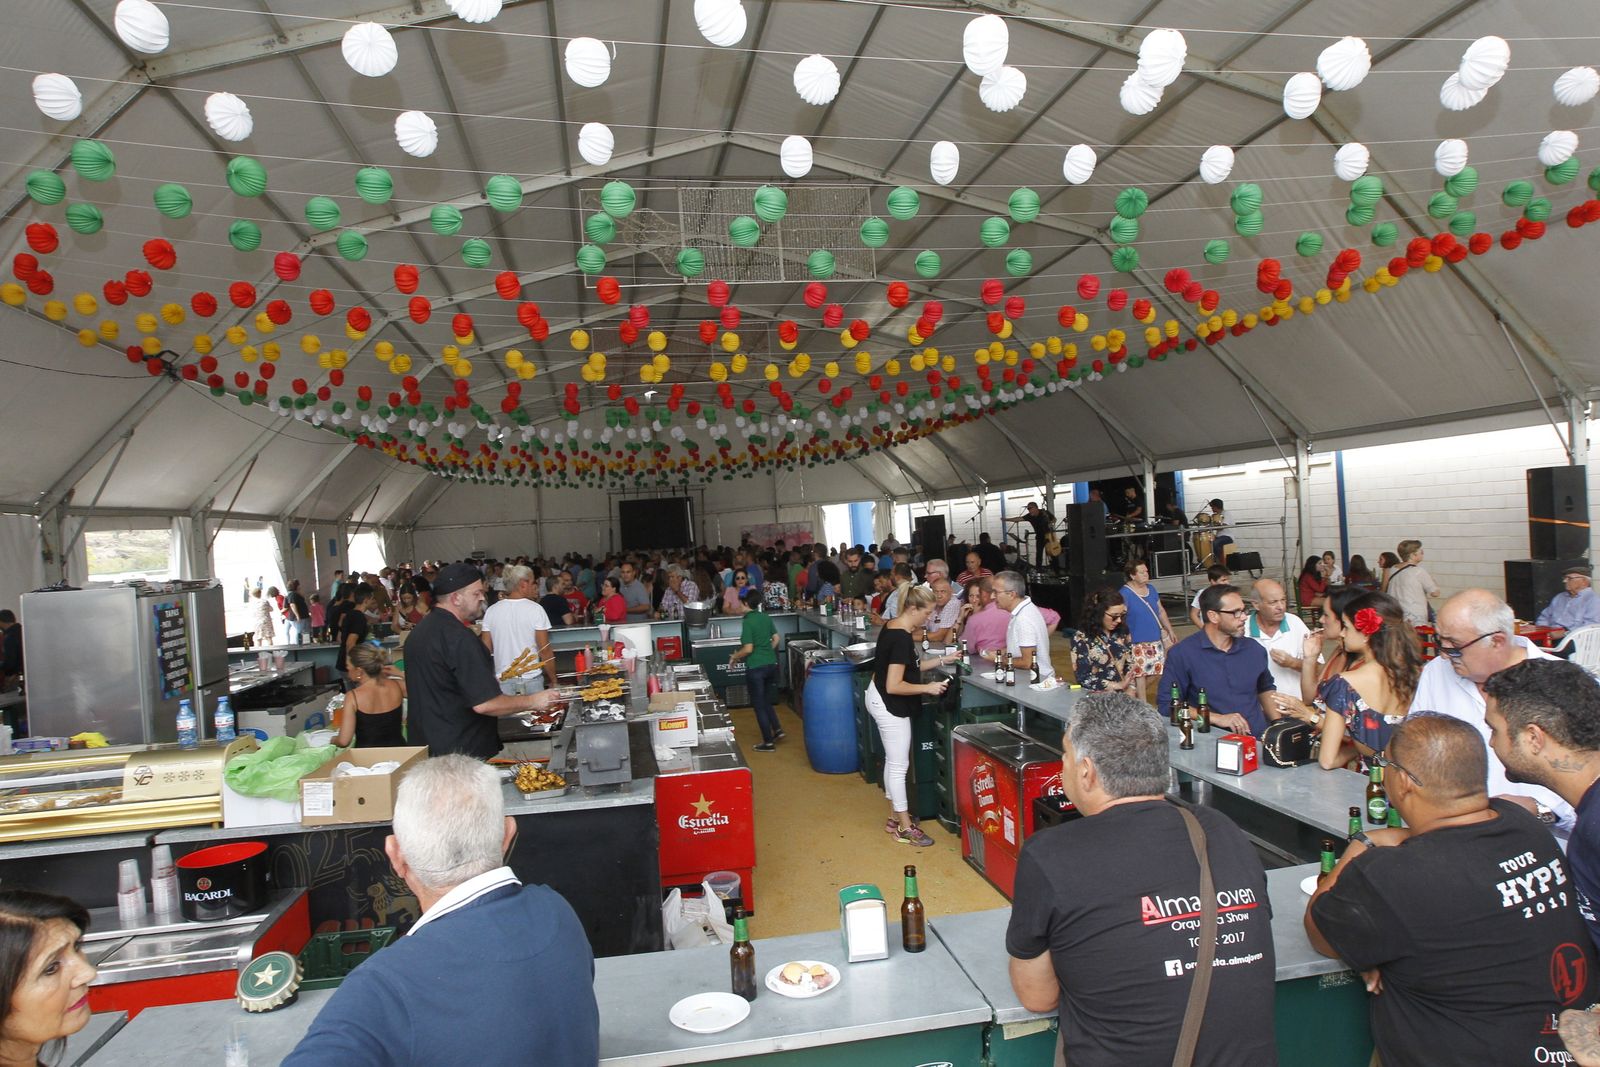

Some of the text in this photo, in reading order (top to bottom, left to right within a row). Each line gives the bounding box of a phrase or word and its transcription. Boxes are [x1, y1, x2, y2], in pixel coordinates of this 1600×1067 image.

[678, 812, 730, 829] Estrella
[1498, 851, 1537, 873] TOUR
[1496, 858, 1567, 907] HYPE
[184, 888, 232, 902] BACARDI
[1141, 887, 1256, 921] Almaoven
[1522, 891, 1567, 919] 2019
[1171, 912, 1250, 932] Orqua Show
[1221, 931, 1246, 945] 2017
